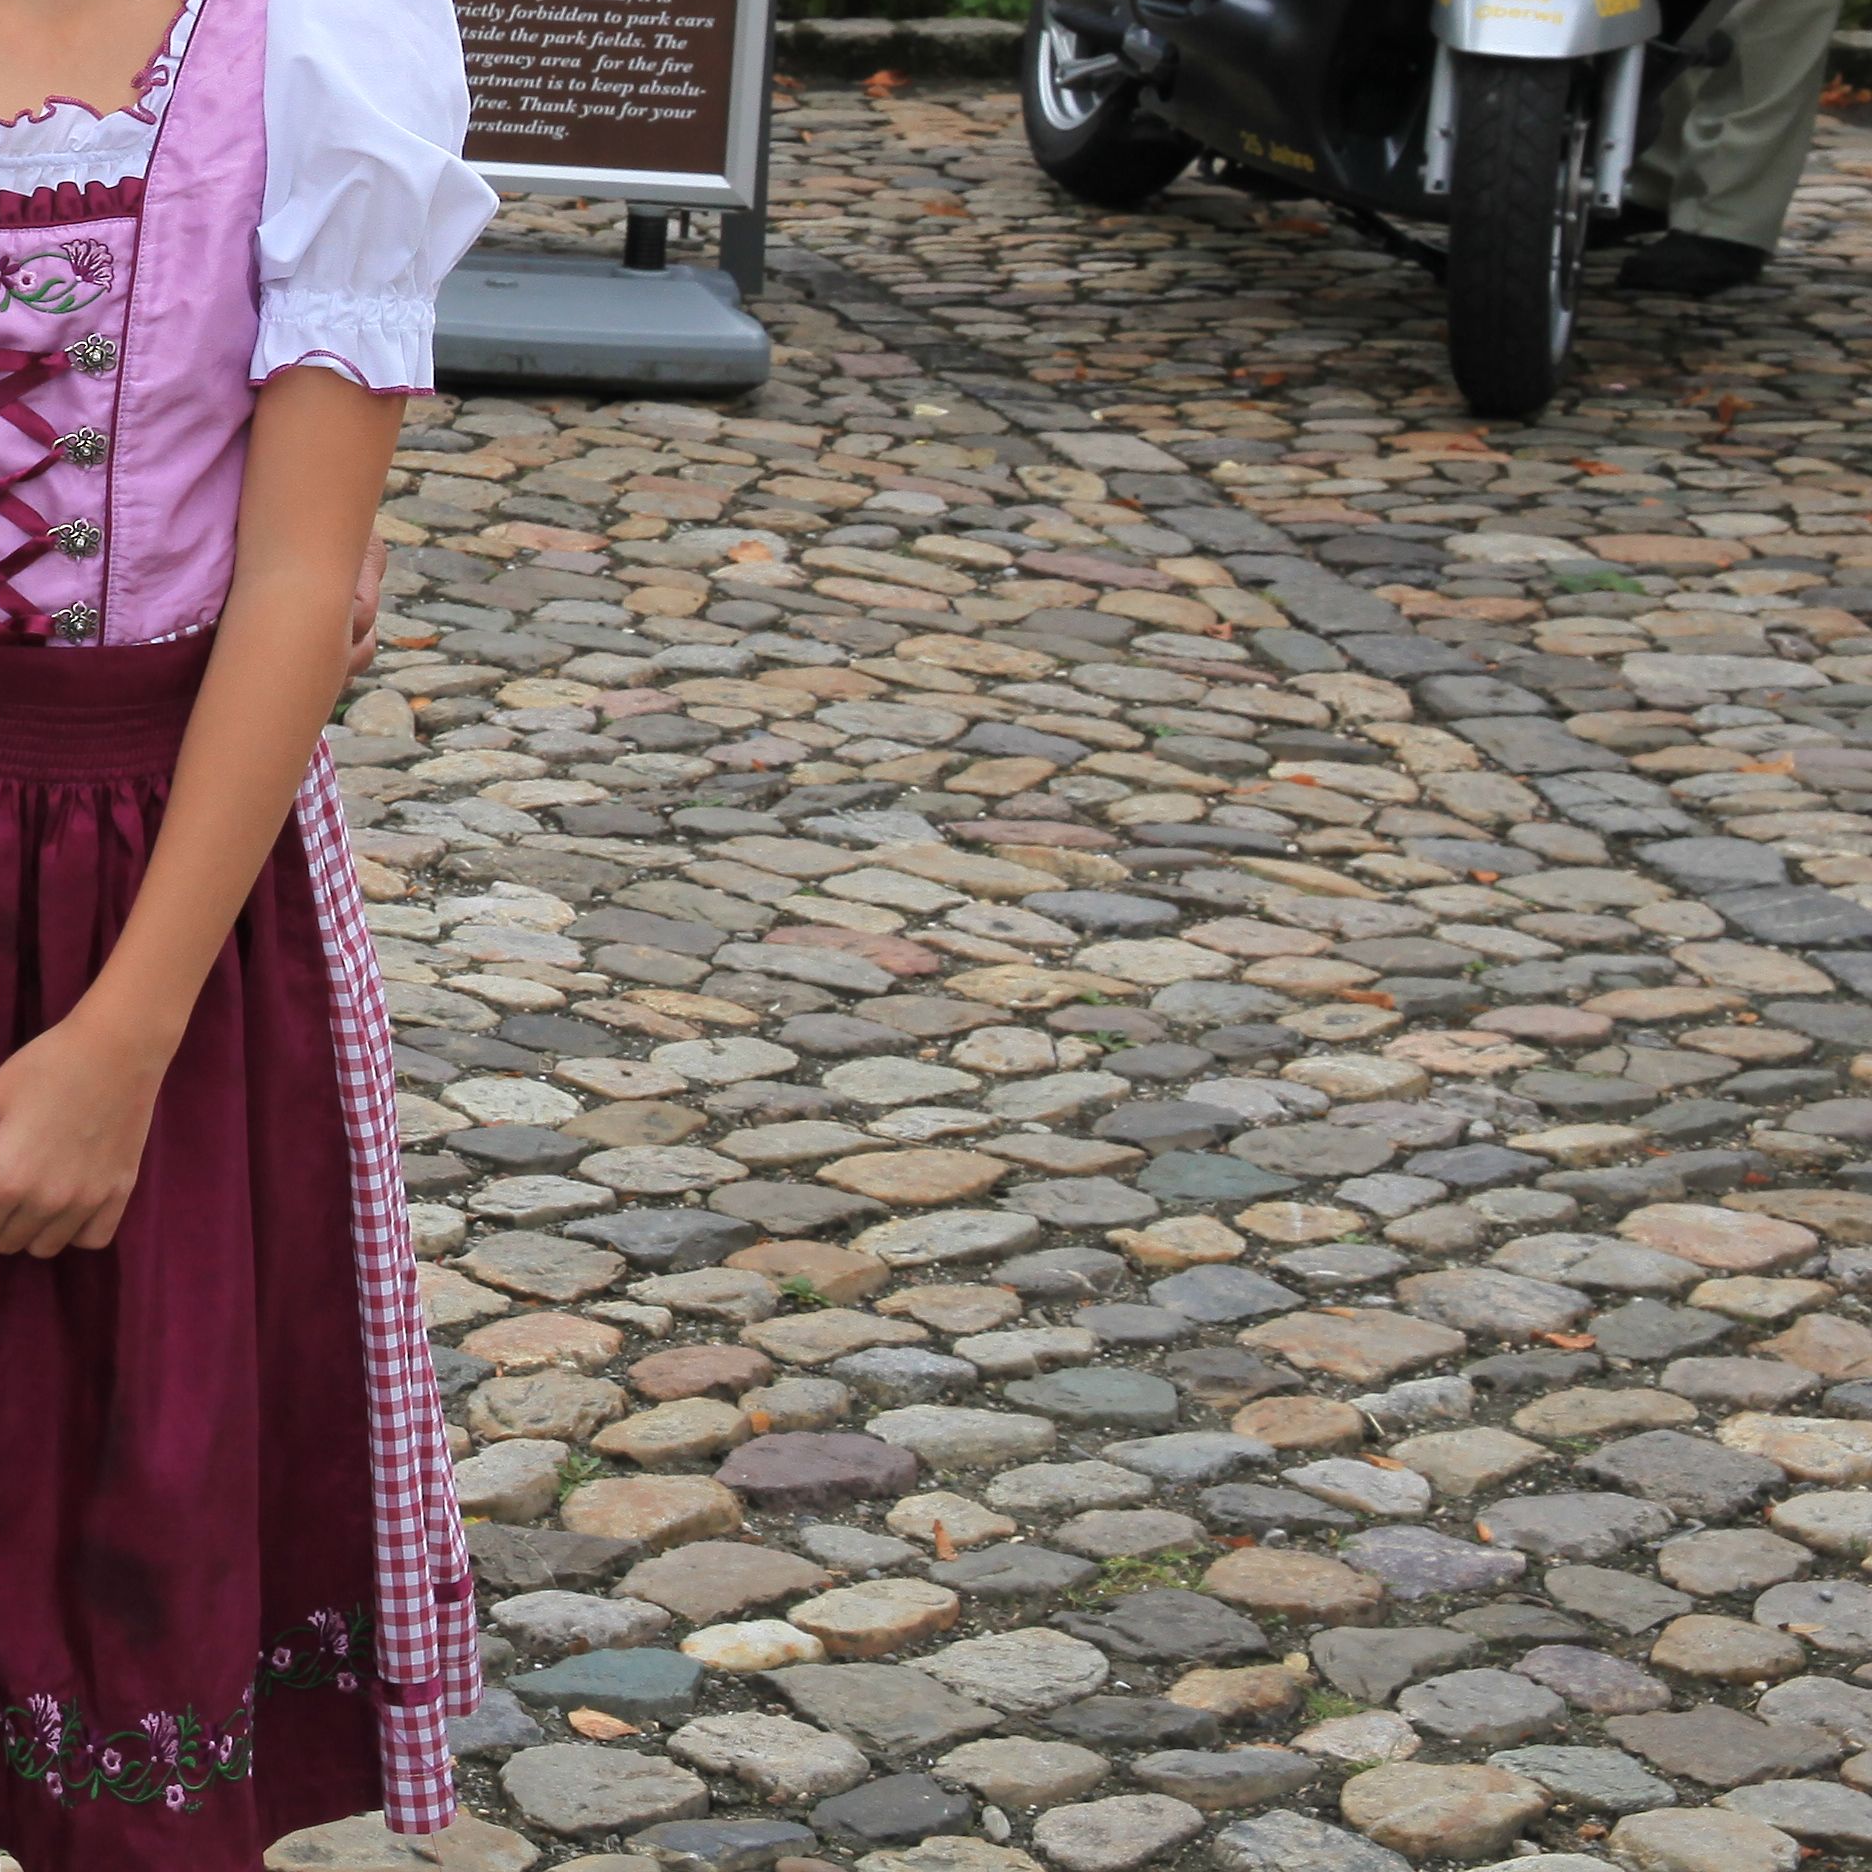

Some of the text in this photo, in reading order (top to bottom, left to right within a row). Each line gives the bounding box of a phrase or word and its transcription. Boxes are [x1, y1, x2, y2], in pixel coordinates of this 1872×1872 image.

[455, 1, 715, 29] rictly forbidden to park cars
[460, 25, 688, 50] tside the park fields. The
[465, 52, 694, 76] ergency area for the fire
[467, 73, 707, 97] artment is to keep absolu-
[471, 94, 697, 121] free. Thank you for your
[468, 119, 570, 140] erstanding.
